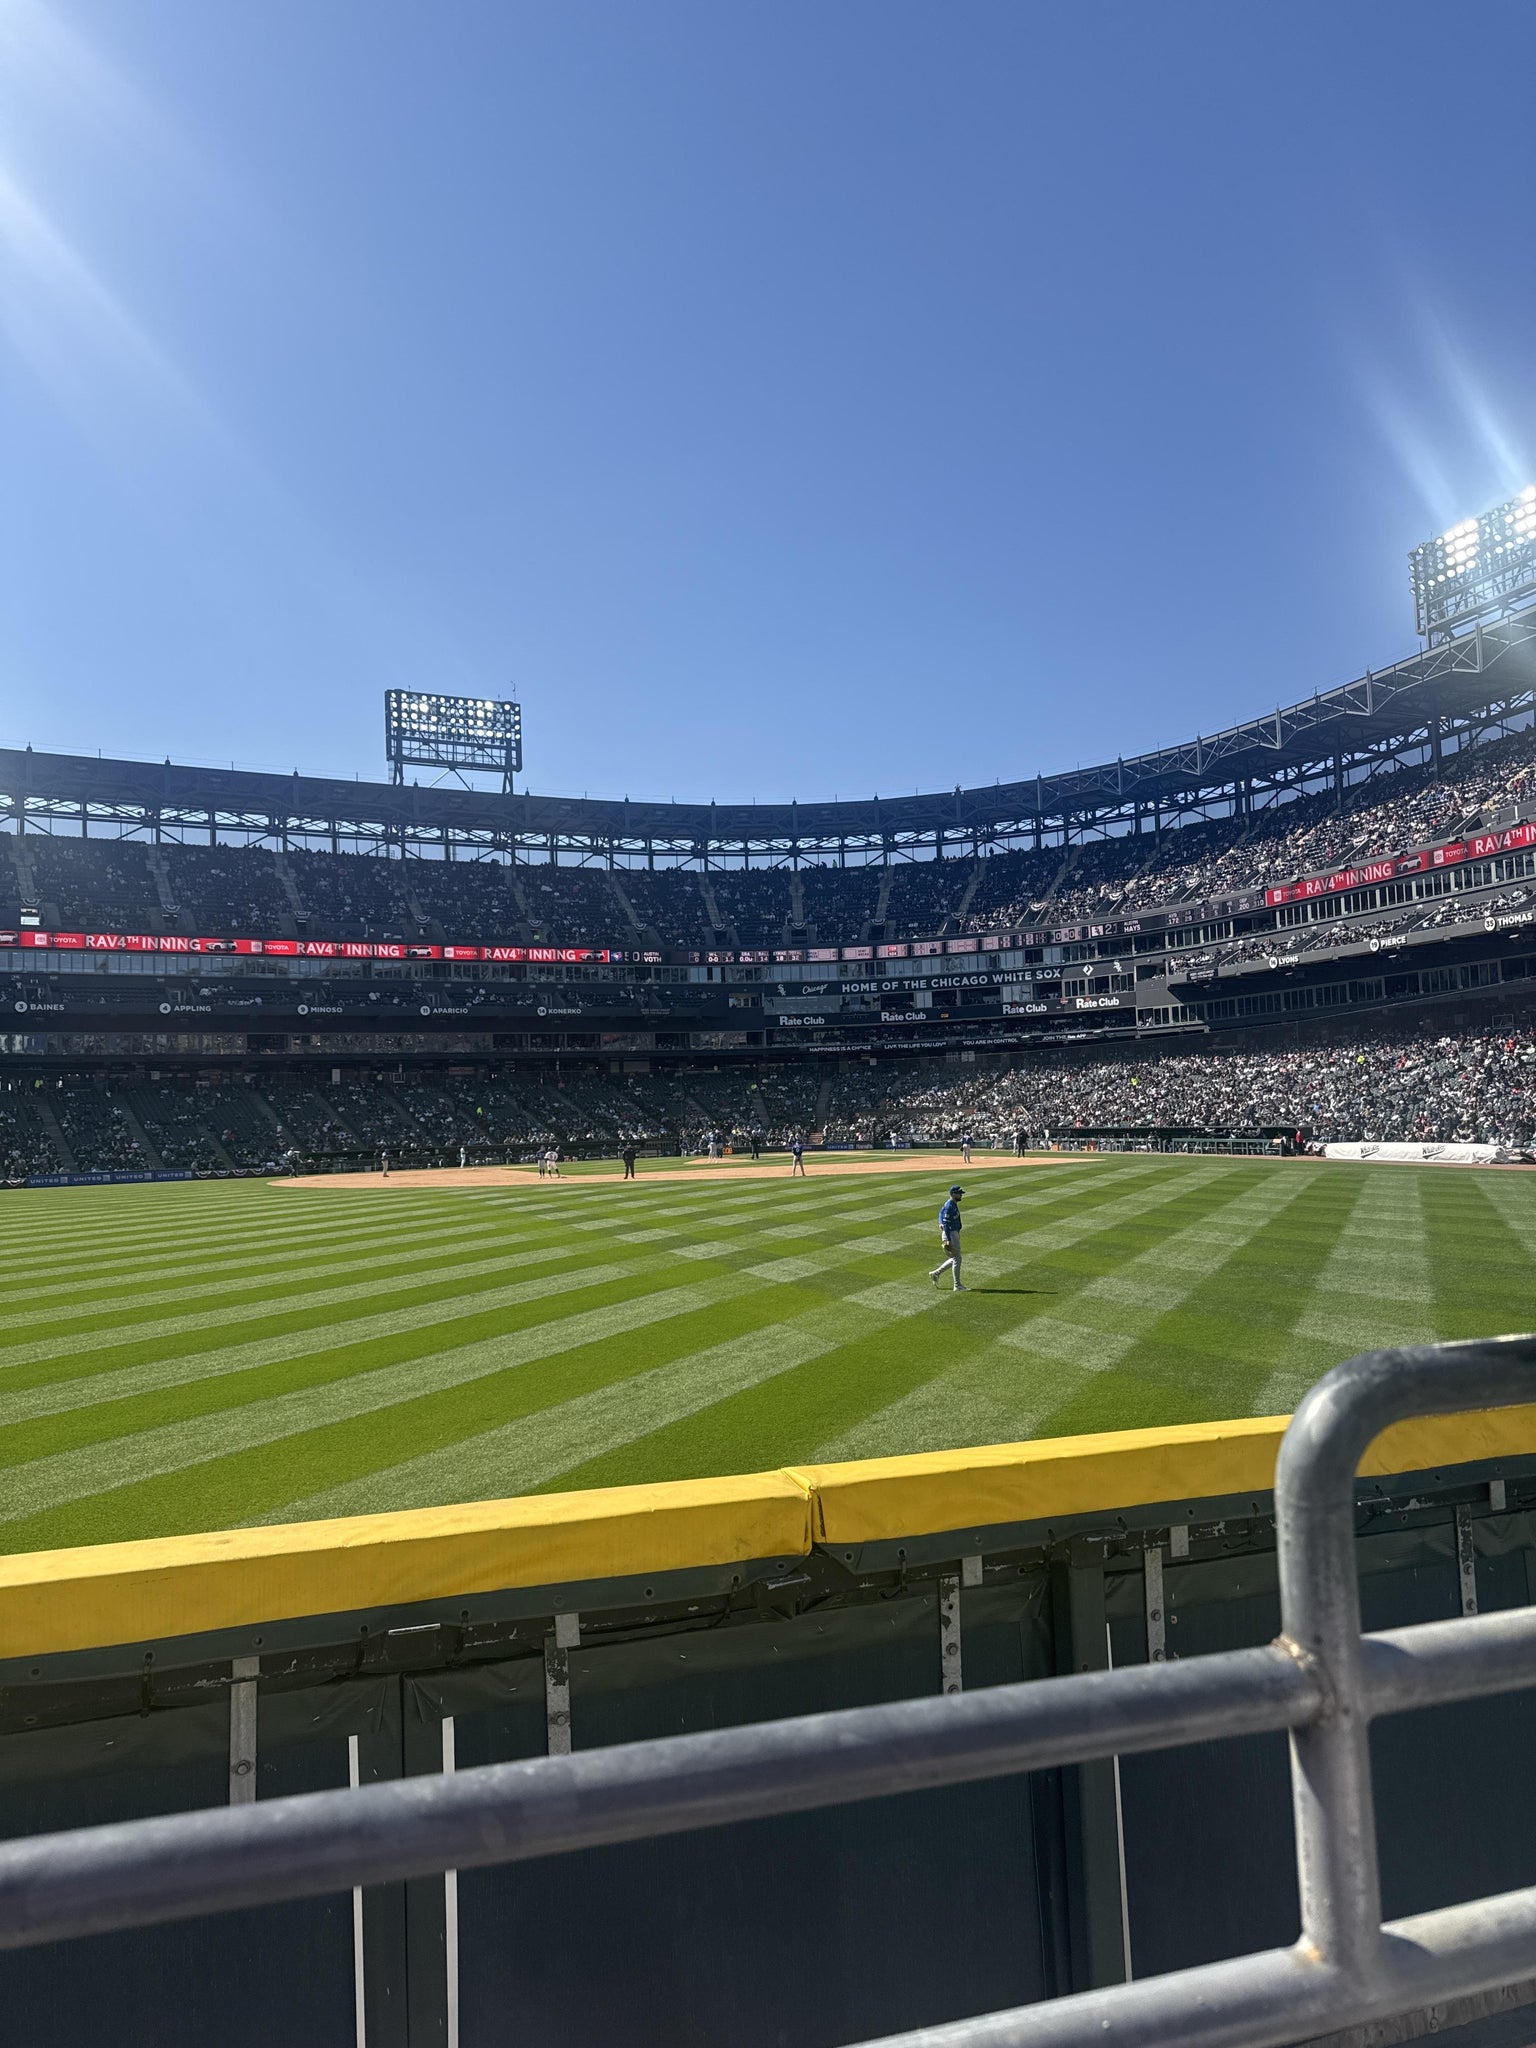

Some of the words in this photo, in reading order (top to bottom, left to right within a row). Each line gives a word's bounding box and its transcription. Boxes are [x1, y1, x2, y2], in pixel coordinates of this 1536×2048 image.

[1445, 847, 1468, 858] TOYOTA
[1346, 863, 1392, 886] INNING
[1282, 888, 1301, 897] TOYOTA
[1498, 912, 1533, 926] THOMAS
[1124, 924, 1141, 933] HAYS
[49, 936, 77, 944] TOYOTA
[142, 936, 201, 951] INNING
[1380, 935, 1406, 947] PIERCE
[347, 944, 400, 957] INNING
[528, 949, 576, 961] INNING
[1278, 956, 1299, 965] LYONS
[841, 983, 878, 993] HOME
[882, 981, 899, 991] OF
[903, 979, 927, 990] THE
[931, 975, 988, 988] CHICAGO
[992, 971, 1032, 983] WHITE
[1036, 968, 1061, 980] SOX
[30, 1003, 65, 1011] BAINES
[1075, 998, 1098, 1009] Rate
[1098, 996, 1120, 1007] Club
[1002, 1004, 1025, 1015] Rate
[1025, 1003, 1048, 1013] Club
[779, 1016, 802, 1026] Rate
[803, 1016, 825, 1025] Club
[881, 1012, 904, 1022] Rate
[905, 1011, 926, 1021] Club
